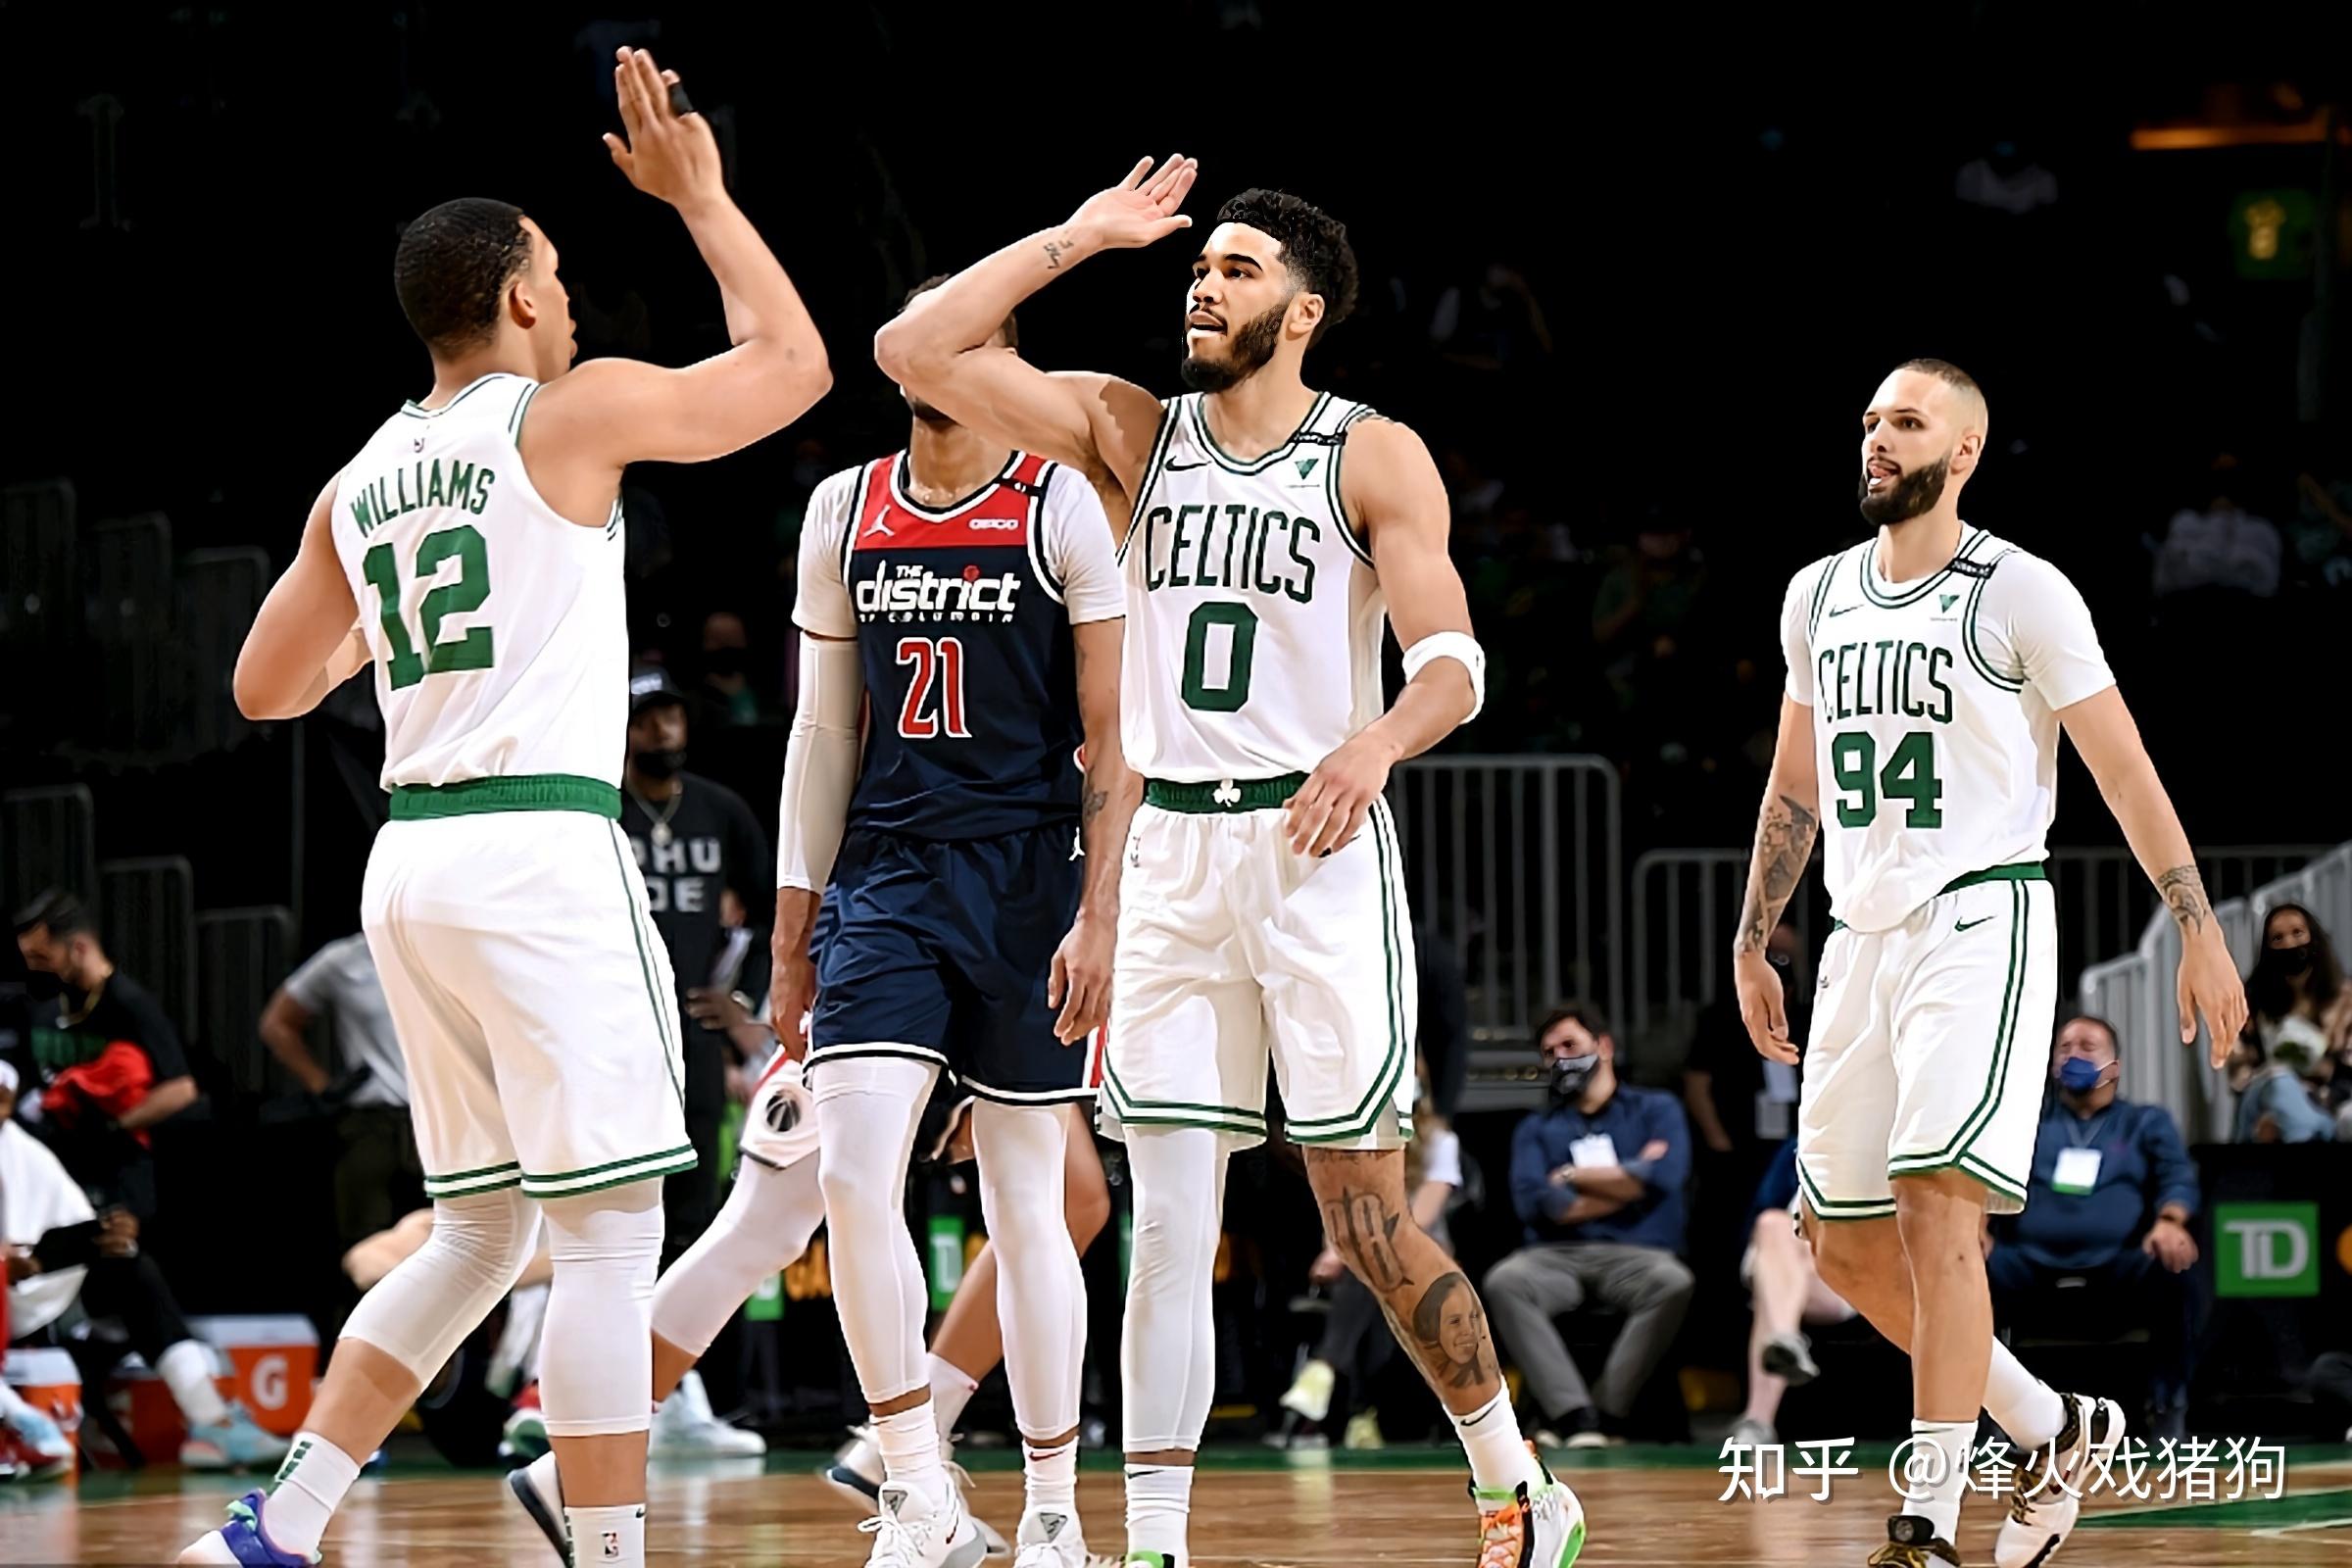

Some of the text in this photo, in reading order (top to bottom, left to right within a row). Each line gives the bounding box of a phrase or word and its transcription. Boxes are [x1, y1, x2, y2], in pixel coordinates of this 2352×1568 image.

[350, 458, 495, 538] WILLIAMS
[857, 560, 1021, 612] district
[896, 565, 924, 578] THE
[1145, 505, 1321, 604] CELTICS
[363, 524, 494, 691] 12
[896, 637, 972, 738] 21
[1181, 601, 1259, 712] 0
[1819, 640, 1953, 724] CELTICS
[1832, 730, 1942, 829] 94
[2224, 1219, 2309, 1280] TD
[252, 1354, 288, 1410] G
